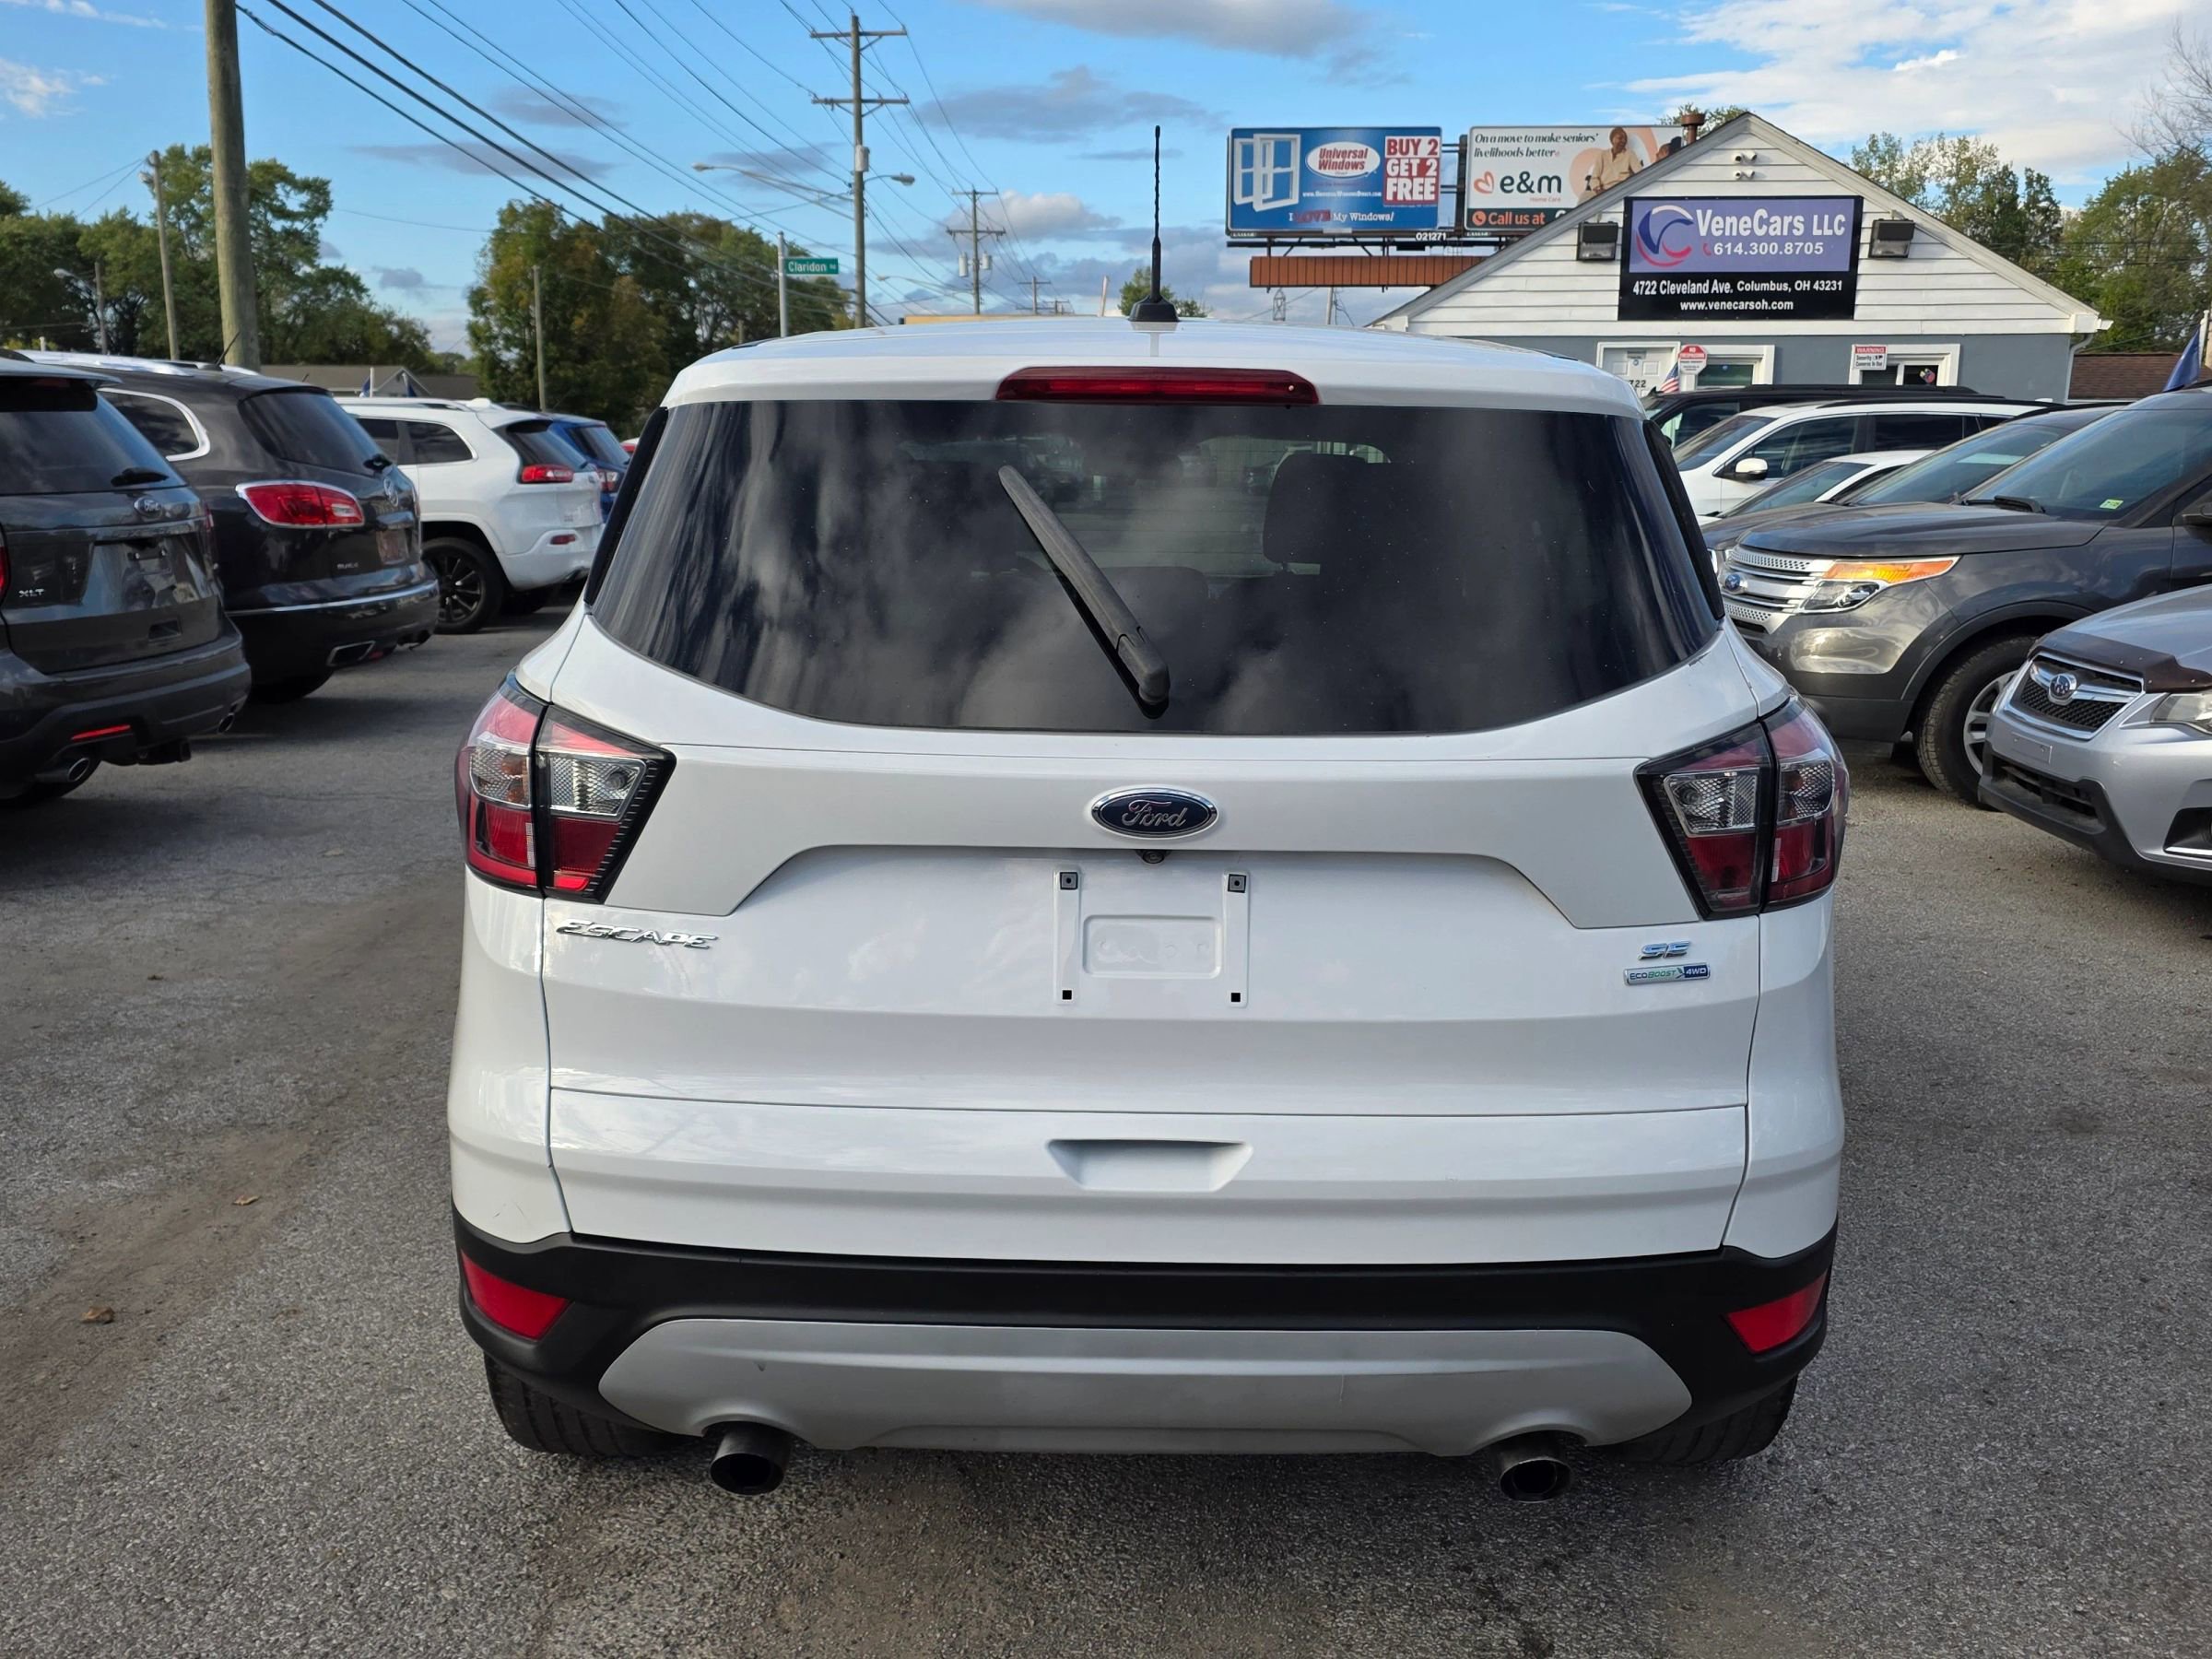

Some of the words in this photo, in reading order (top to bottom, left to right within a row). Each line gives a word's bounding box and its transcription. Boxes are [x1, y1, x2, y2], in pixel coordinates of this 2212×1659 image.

[1475, 134, 1488, 143] On
[1524, 134, 1534, 143] to
[1535, 133, 1561, 143] make
[1319, 147, 1369, 159] Universal
[1386, 139, 1421, 155] BUY
[1428, 139, 1438, 155] 2
[1474, 147, 1524, 158] livelihoods
[1318, 159, 1365, 171] Windows
[1386, 159, 1421, 176] GET
[1426, 159, 1438, 176] 2
[1500, 171, 1562, 194] e&m
[1386, 178, 1436, 201] FREE
[1333, 212, 1347, 223] My
[1488, 212, 1512, 225] Call
[1515, 214, 1530, 225] us
[1532, 212, 1546, 225] at
[1696, 208, 1805, 237] VeneCars
[1812, 214, 1846, 236] LLC
[1416, 232, 1447, 241] 021271
[1713, 242, 1824, 255] 614.300.8705
[788, 261, 827, 273] Claridon
[1633, 280, 1657, 295] 4722
[1659, 280, 1709, 295] Cleveland
[1711, 279, 1734, 294] Ave.
[1737, 280, 1792, 292] Columbus,
[1794, 280, 1811, 291] OH
[1813, 280, 1843, 291] 43231
[1680, 299, 1794, 311] www.venecarsoh.com
[18, 588, 44, 597] XLT
[1122, 799, 1188, 827] Ford
[556, 919, 718, 949] ESCAPE
[1630, 970, 1677, 980] ECOBOOST
